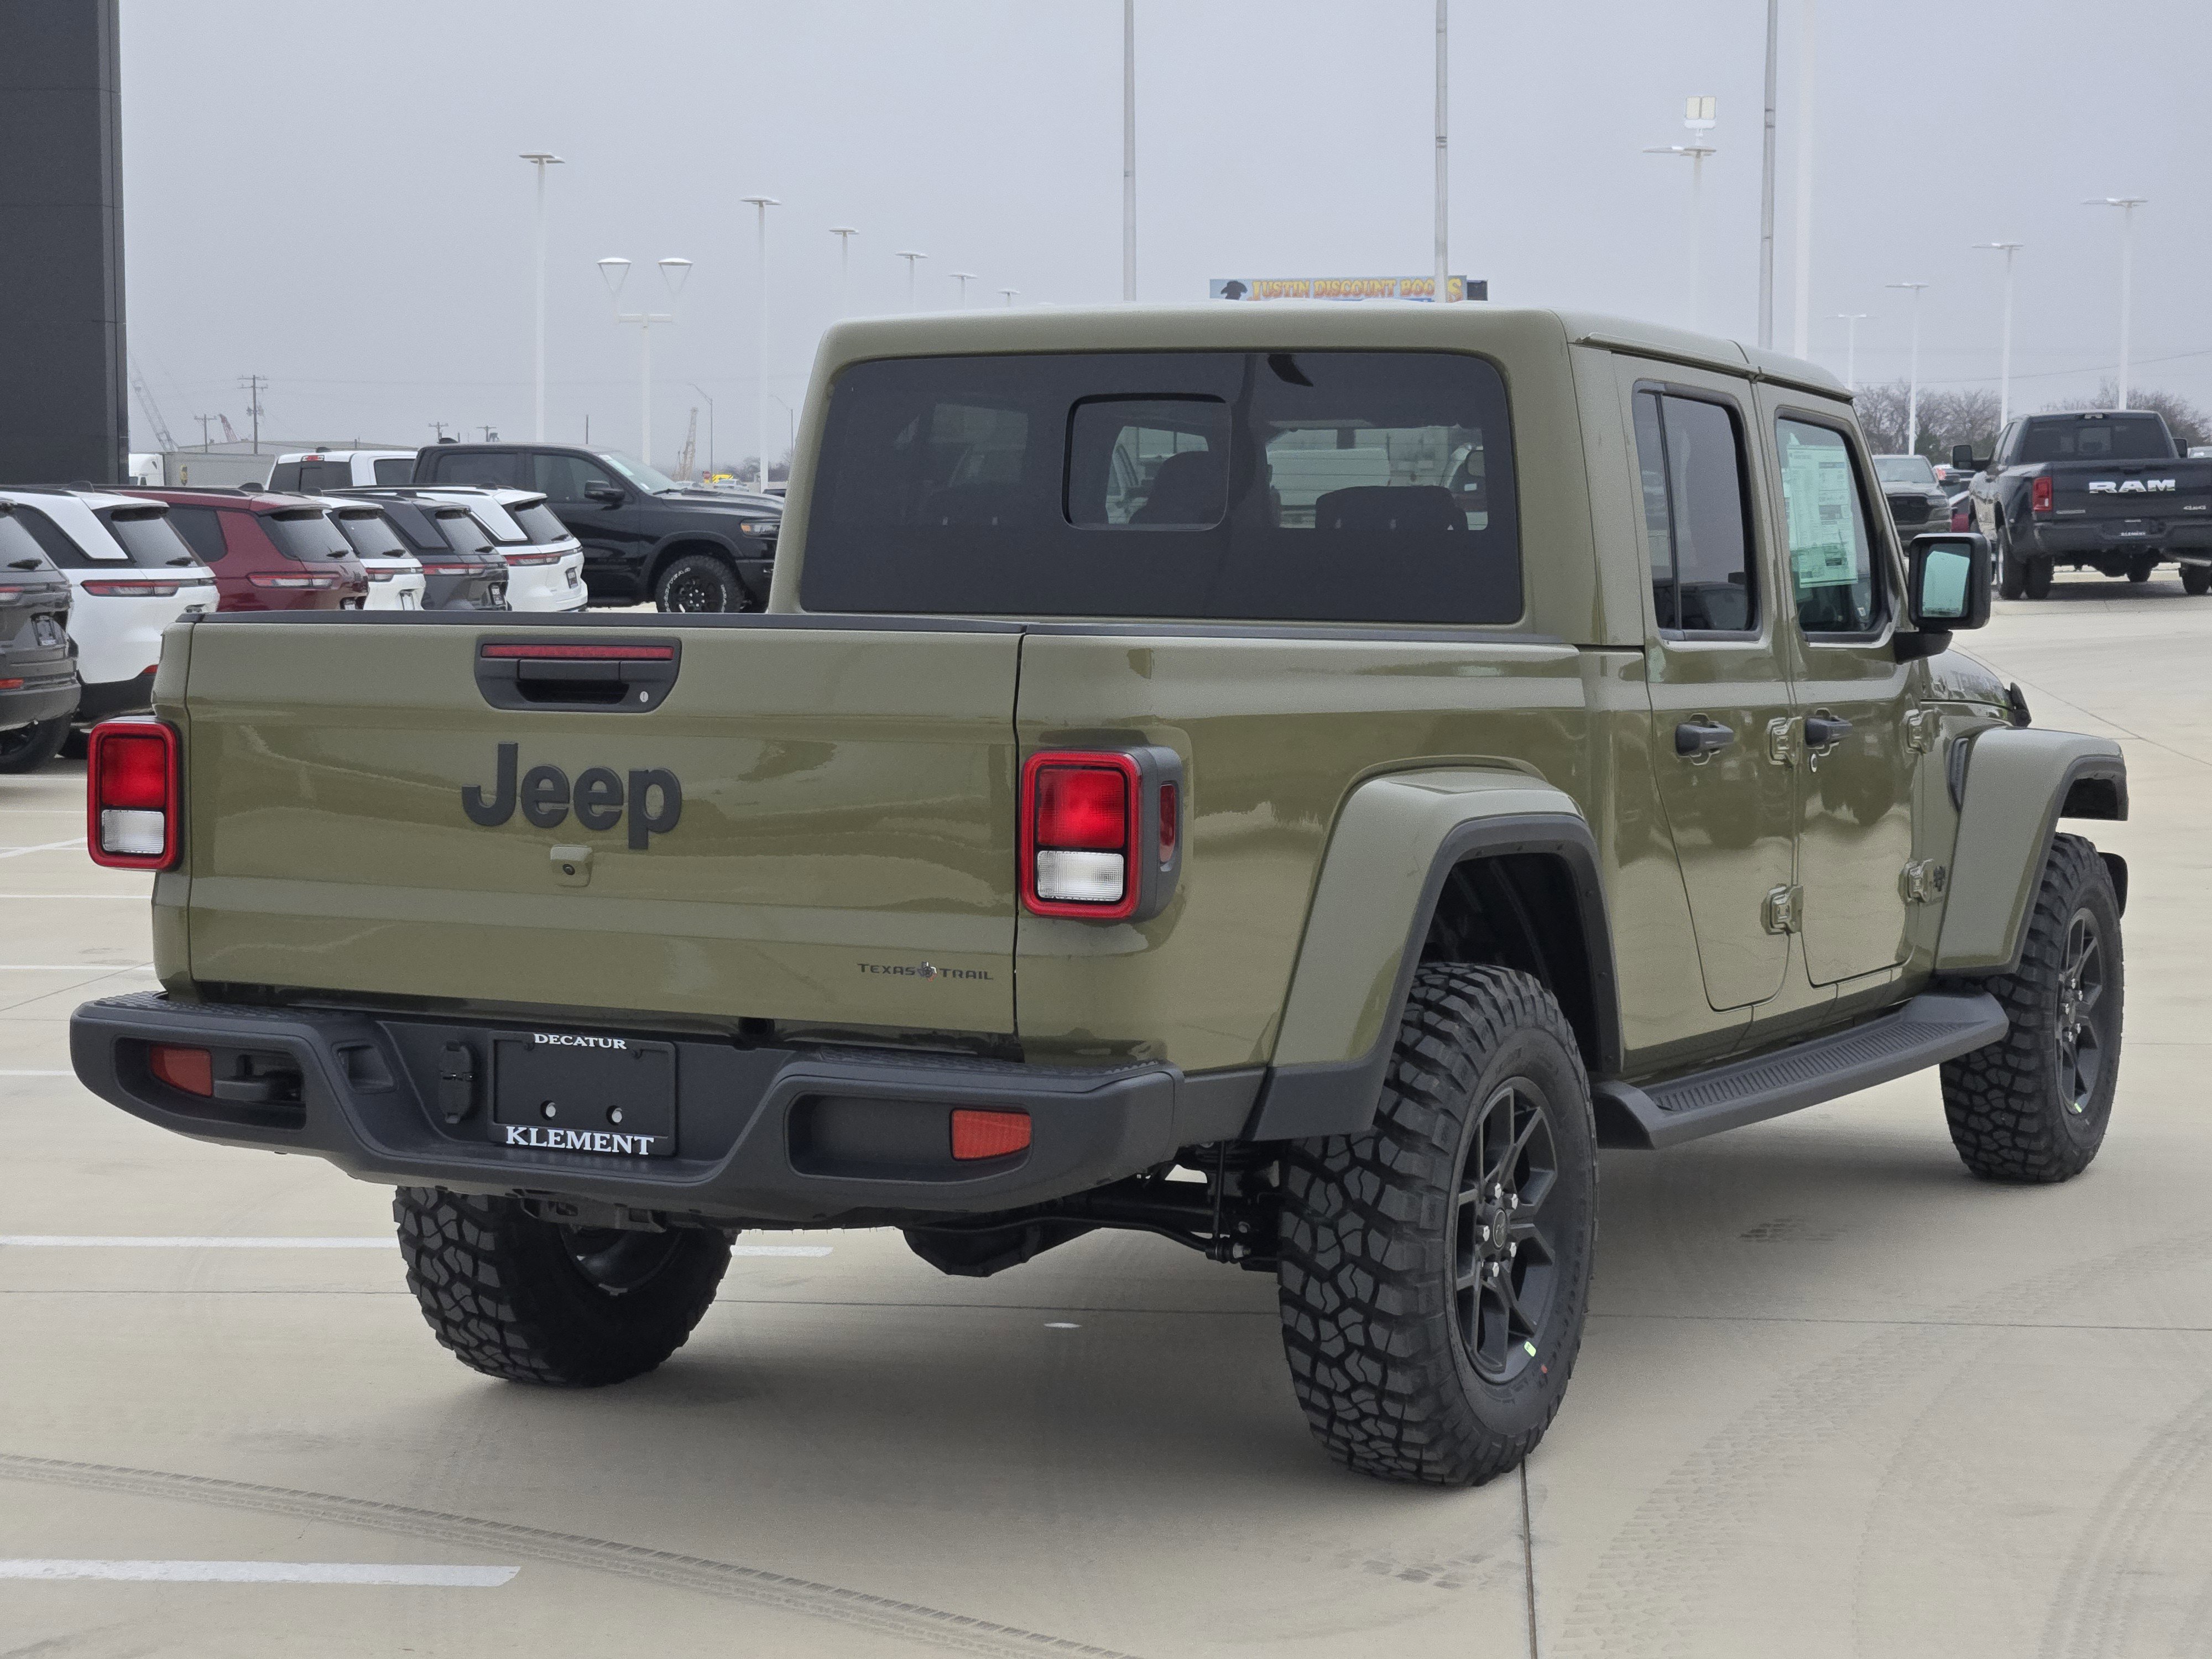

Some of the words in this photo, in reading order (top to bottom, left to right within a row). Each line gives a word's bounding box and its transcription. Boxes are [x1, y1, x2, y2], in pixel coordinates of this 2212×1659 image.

[1246, 280, 1310, 301] JUSTIN
[1313, 279, 1396, 299] DISCOUNT
[1400, 278, 1463, 303] BOOS
[2089, 479, 2176, 494] RAM
[461, 741, 682, 850] Jeep
[857, 963, 916, 976] TEXAS
[939, 968, 994, 980] TRAIL
[534, 1033, 627, 1050] DECATUR
[505, 1125, 655, 1156] KLEMENT
